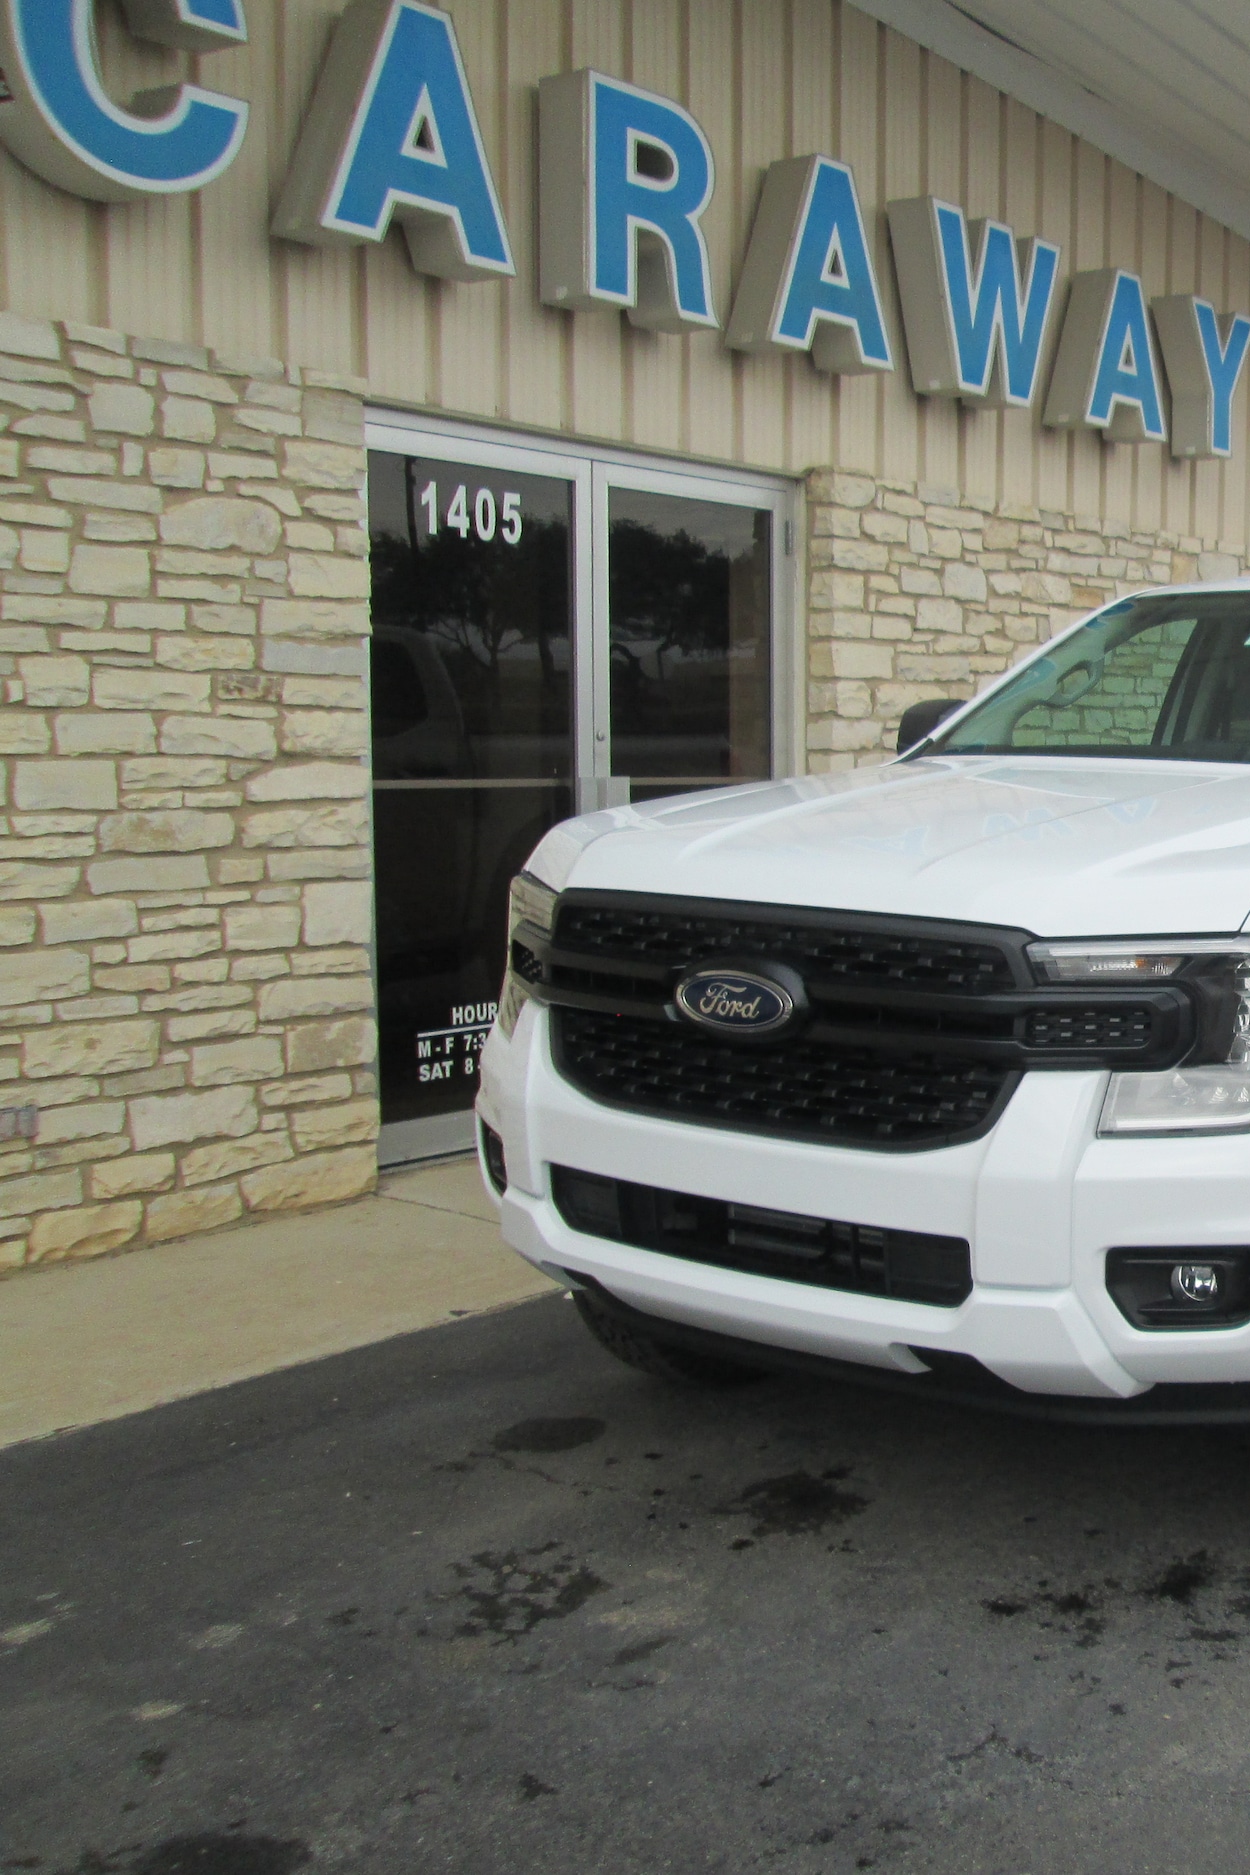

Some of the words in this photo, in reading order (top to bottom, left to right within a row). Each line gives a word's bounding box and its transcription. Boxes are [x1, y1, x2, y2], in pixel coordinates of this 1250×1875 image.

[420, 480, 523, 544] 1405
[700, 982, 762, 1019] Ford
[452, 1001, 499, 1026] HOUR
[463, 1033, 487, 1052] 7:3
[418, 1061, 454, 1082] SAT
[464, 1057, 474, 1075] 8
